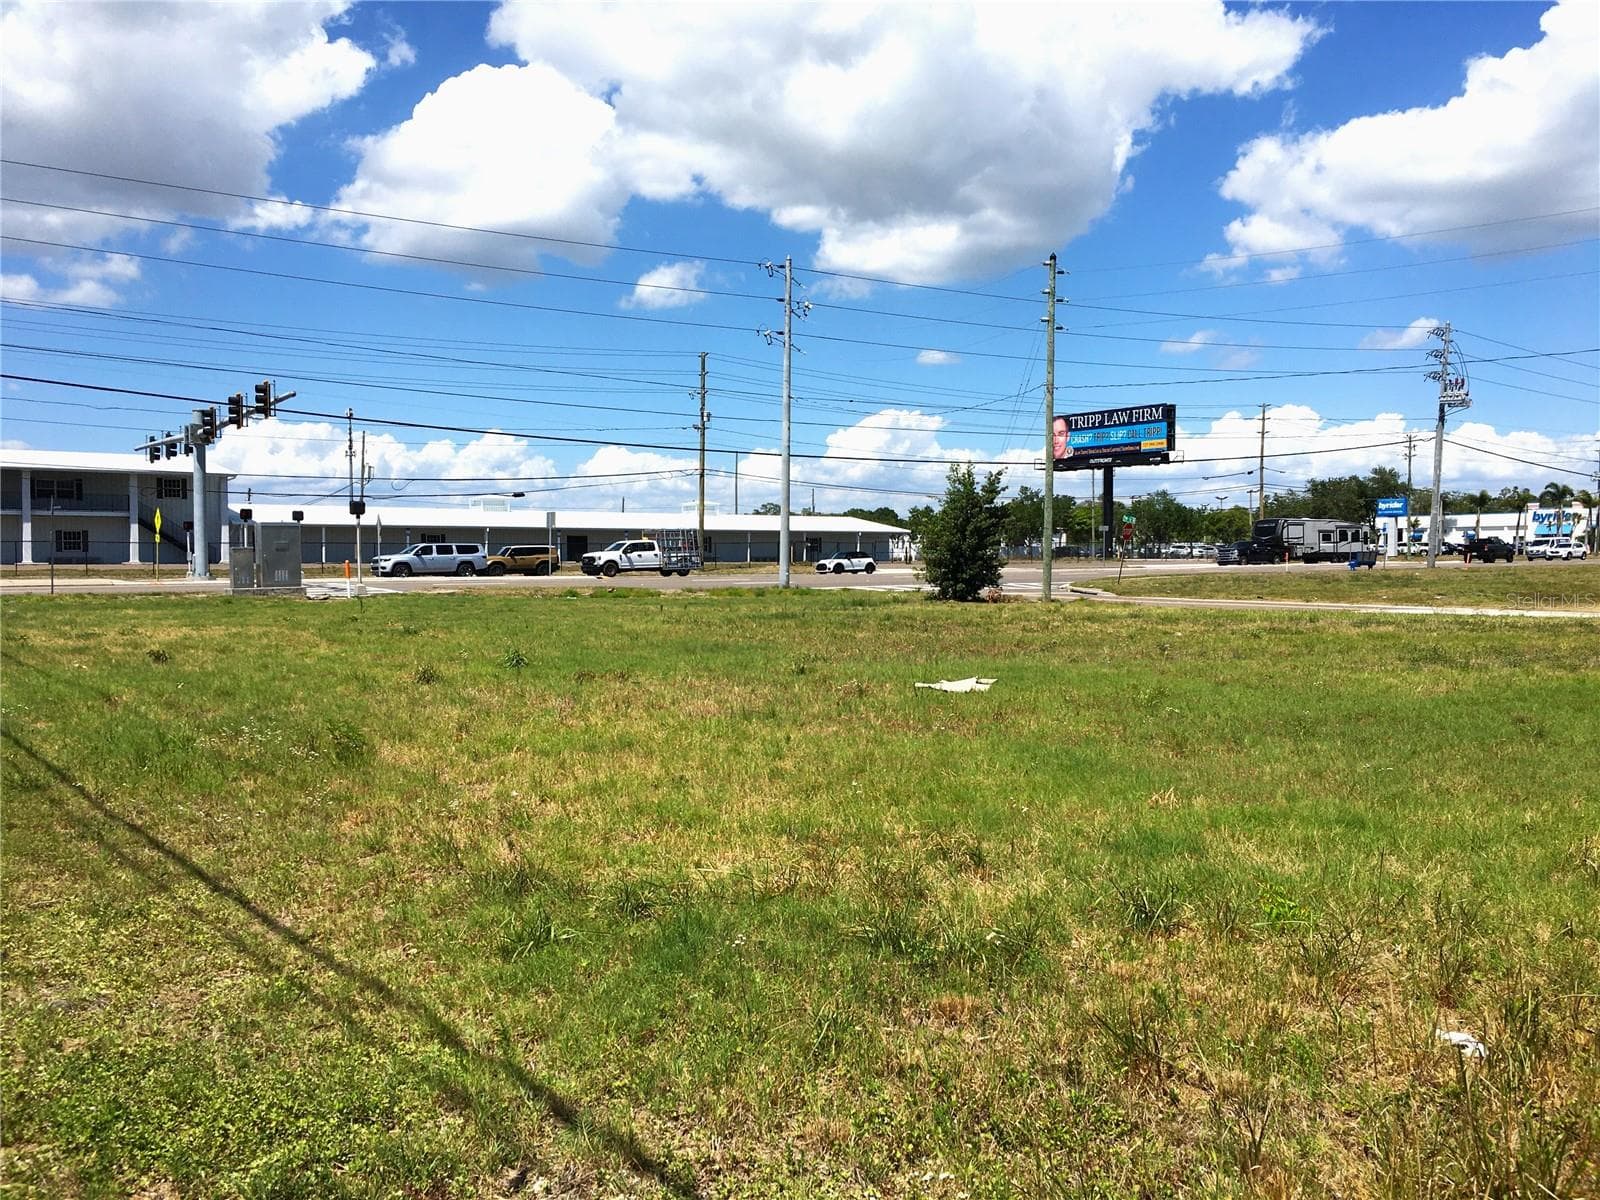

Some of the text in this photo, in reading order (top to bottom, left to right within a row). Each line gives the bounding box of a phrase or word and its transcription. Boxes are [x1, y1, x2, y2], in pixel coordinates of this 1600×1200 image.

[1069, 406, 1163, 429] TRIPP LAW FIRM
